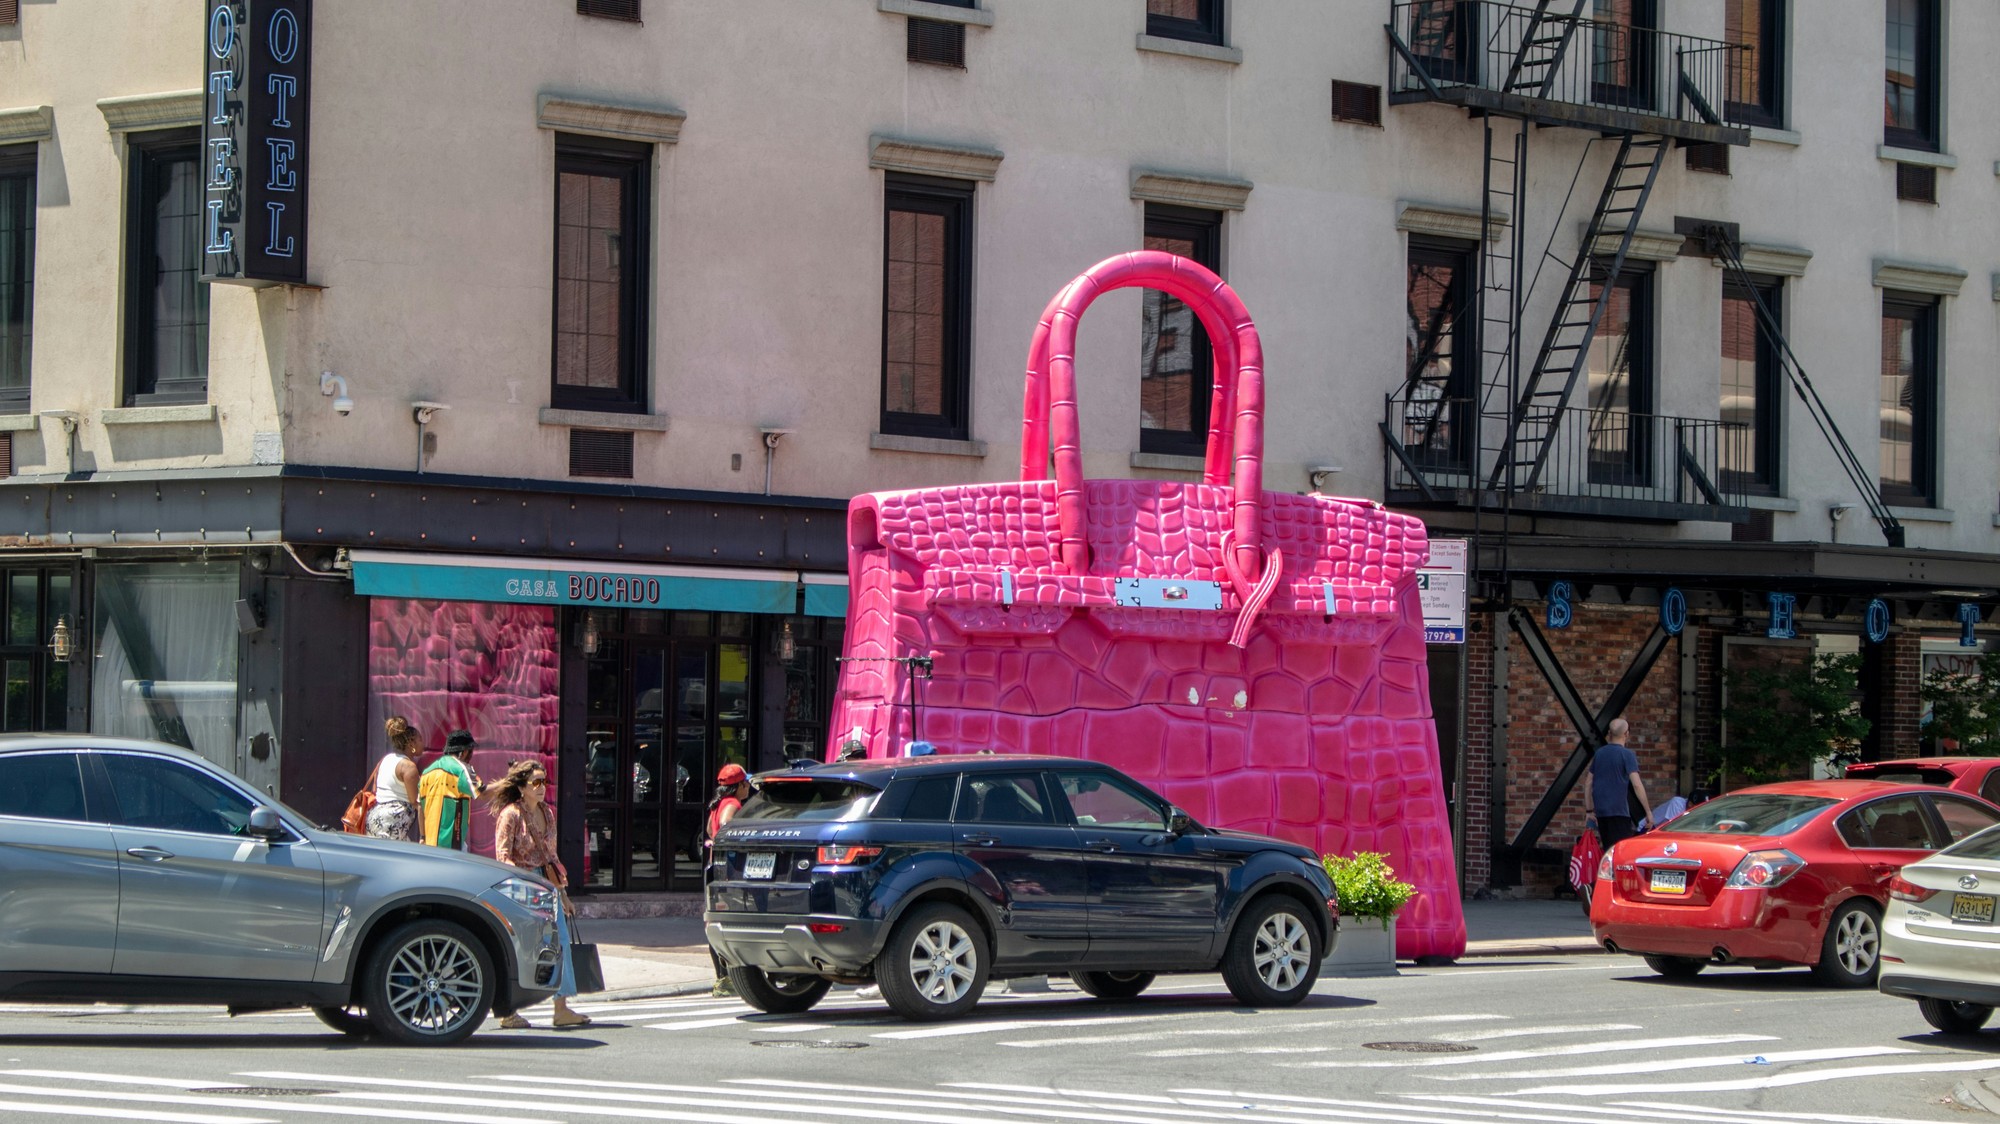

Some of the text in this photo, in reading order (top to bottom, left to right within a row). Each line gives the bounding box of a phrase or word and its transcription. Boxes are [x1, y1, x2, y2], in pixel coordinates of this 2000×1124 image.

[506, 575, 660, 604] CASA BOCADO
[1417, 575, 1425, 589] 2
